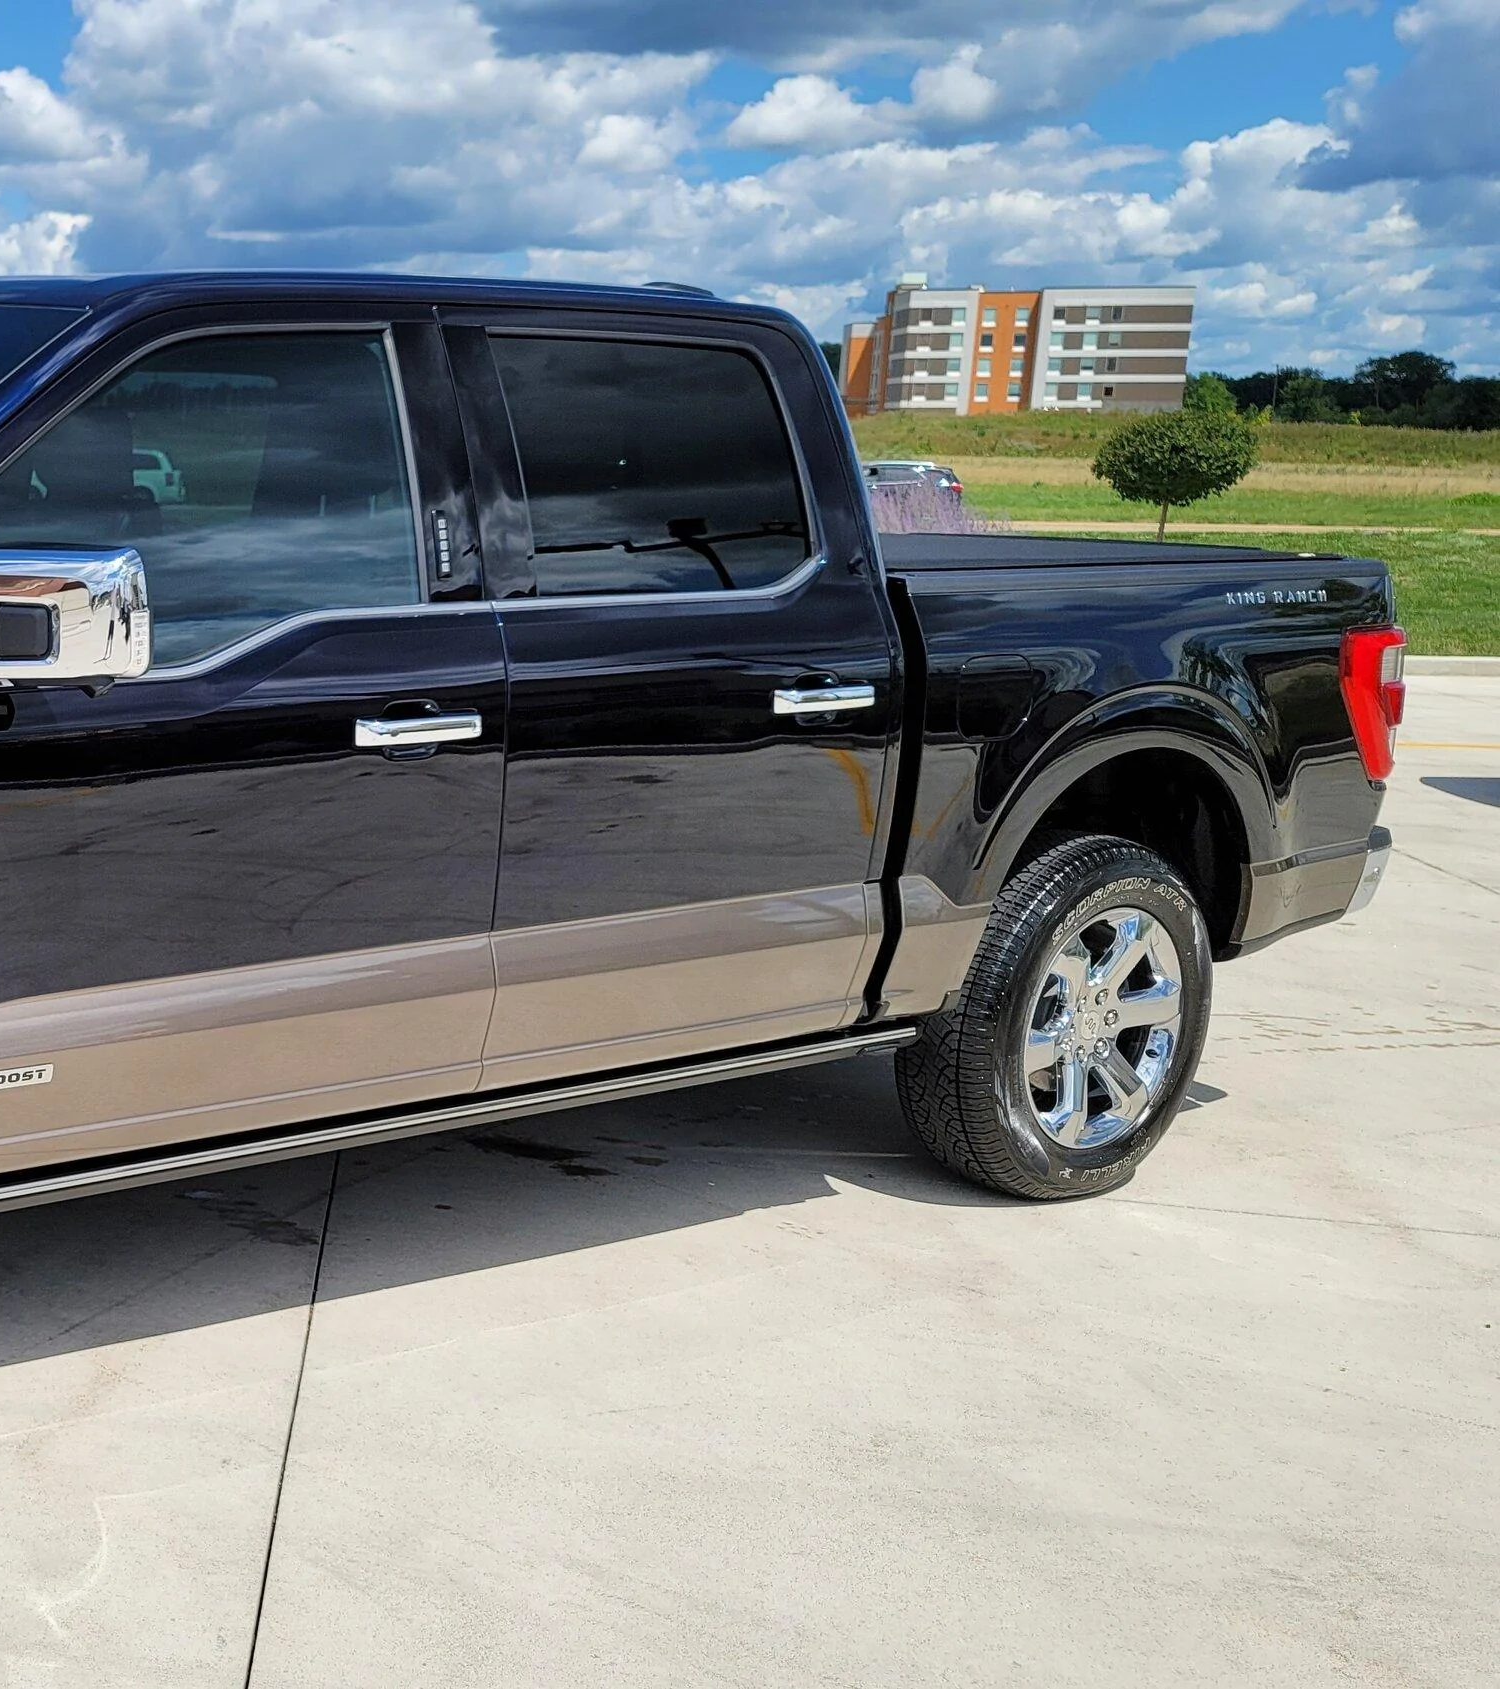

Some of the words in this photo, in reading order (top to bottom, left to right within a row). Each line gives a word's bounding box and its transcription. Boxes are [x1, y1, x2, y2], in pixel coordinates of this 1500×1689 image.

[1226, 592, 1266, 605] KING
[1272, 589, 1328, 603] RANCH
[1052, 877, 1152, 946] SCORPION
[1154, 884, 1188, 912] ATR
